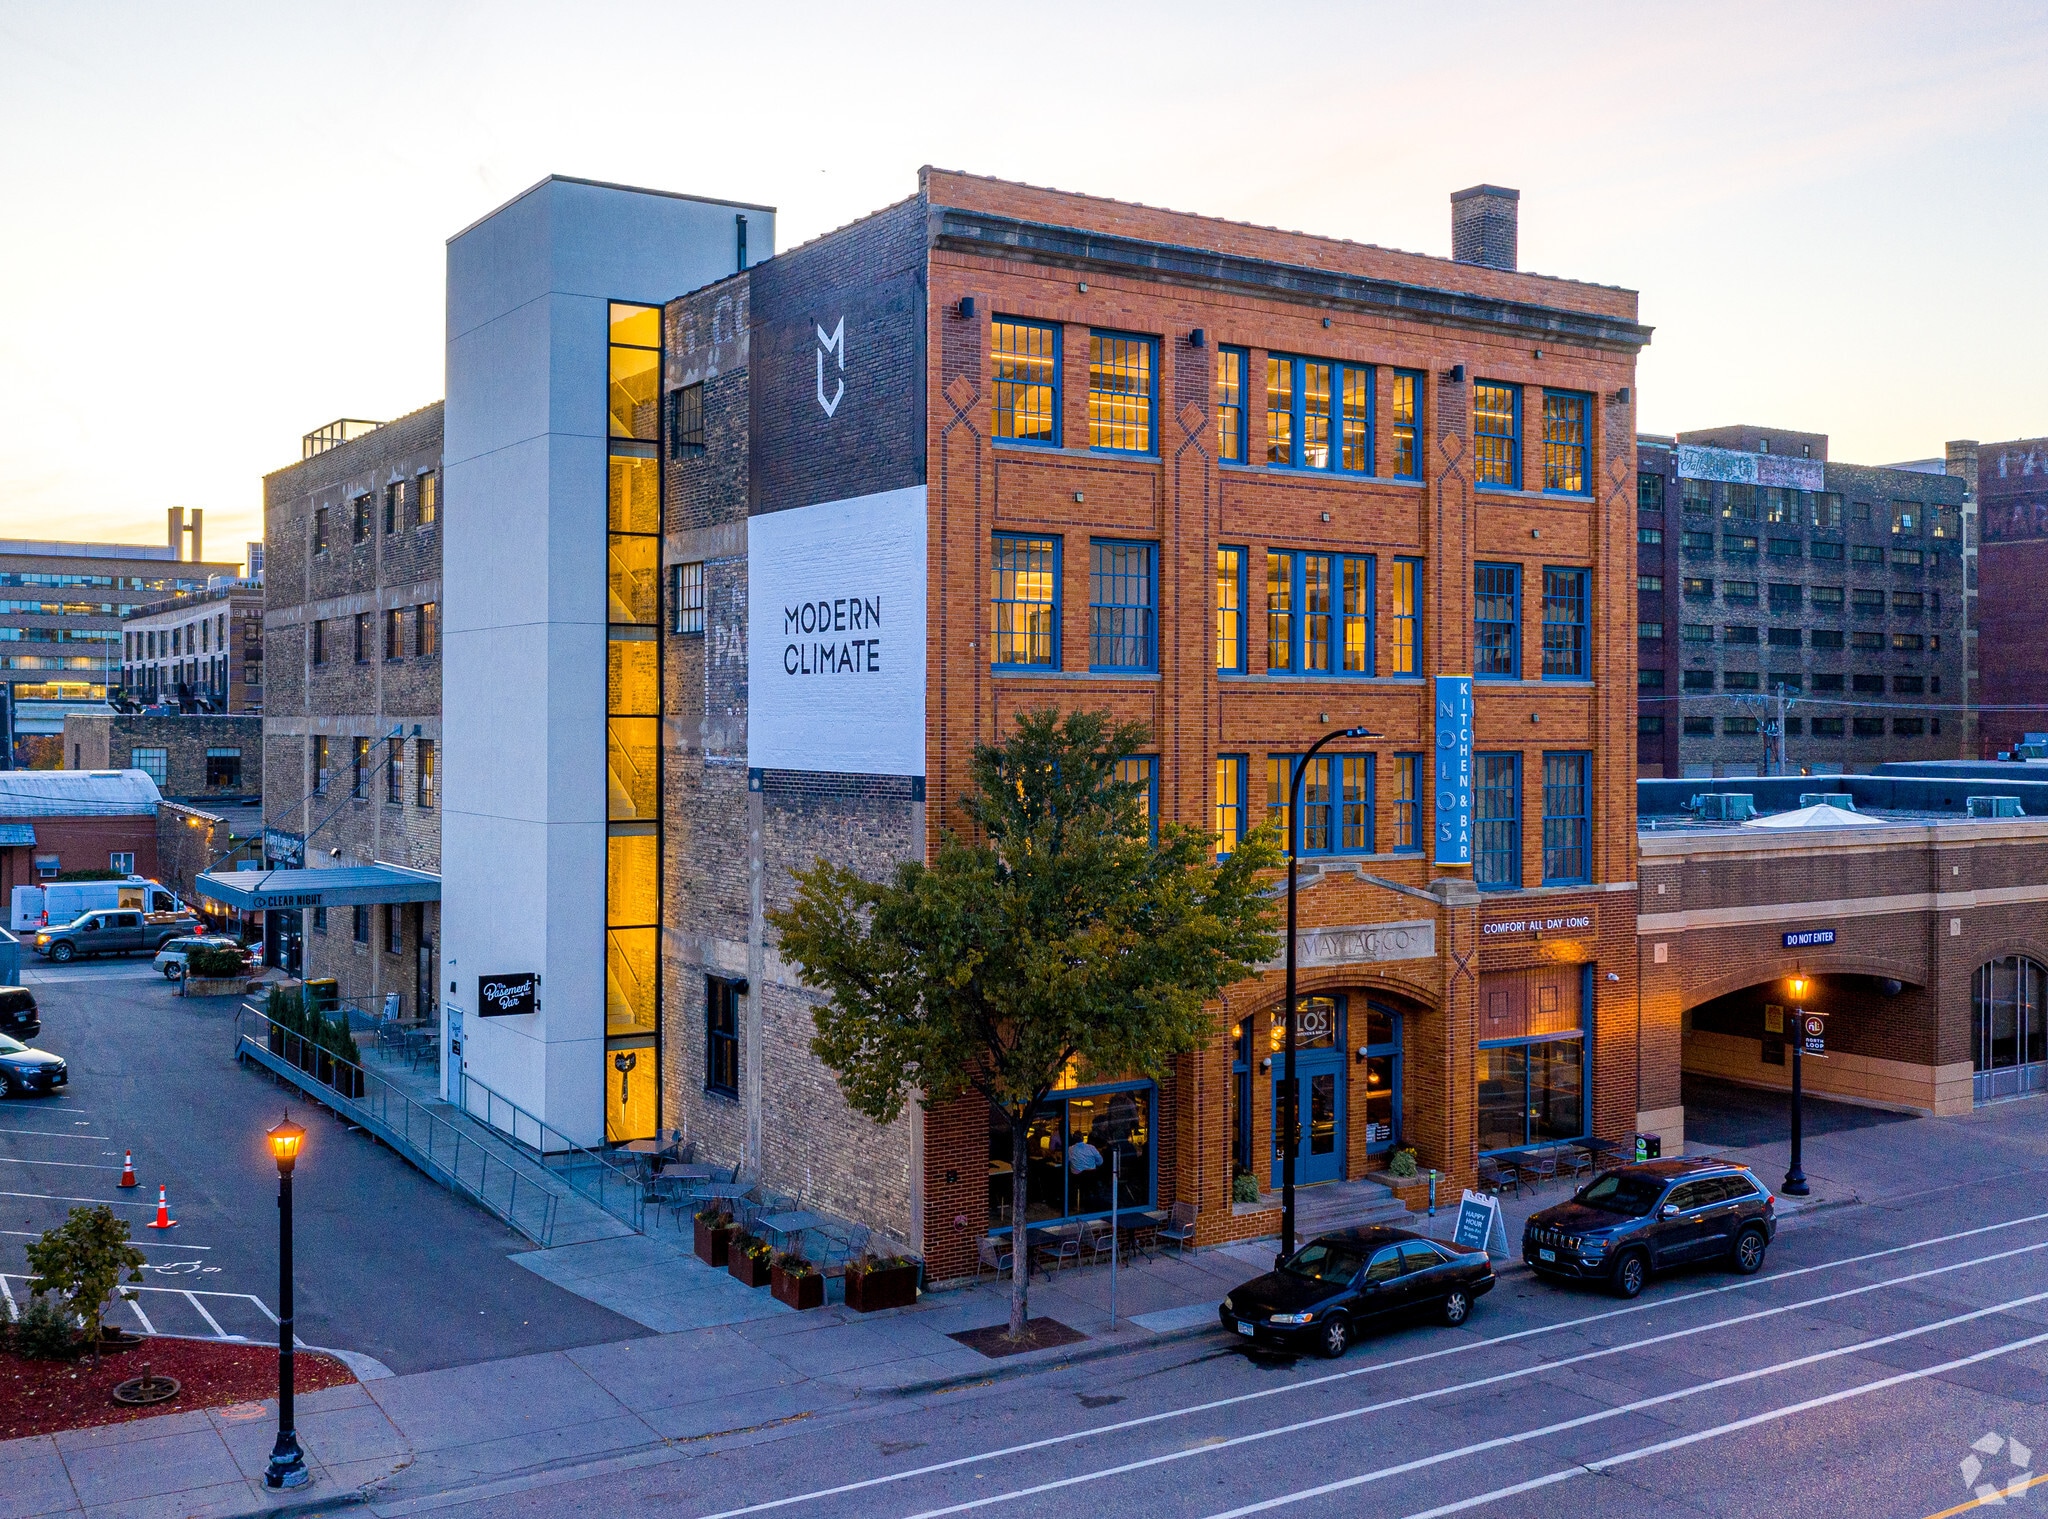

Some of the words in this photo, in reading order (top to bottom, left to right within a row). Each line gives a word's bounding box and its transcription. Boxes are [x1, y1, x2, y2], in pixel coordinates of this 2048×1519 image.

[784, 595, 880, 635] MODERN
[784, 639, 880, 675] CLIMATE
[1459, 682, 1468, 788] KITCHEN
[1459, 815, 1468, 858] BAR
[267, 895, 294, 907] CLEAR
[296, 894, 322, 906] NIGHT
[1483, 921, 1526, 934] COMFORT
[1529, 920, 1543, 930] ALL
[1547, 918, 1563, 929] DAY
[1566, 916, 1590, 928] LONG
[1787, 935, 1798, 945] DO
[1798, 933, 1812, 944] NOT
[1813, 931, 1834, 943] ENTER
[483, 980, 532, 1001] Basement
[498, 995, 520, 1010] Bar
[1465, 1209, 1485, 1221] HAPPY
[1465, 1218, 1483, 1228] HOUR
